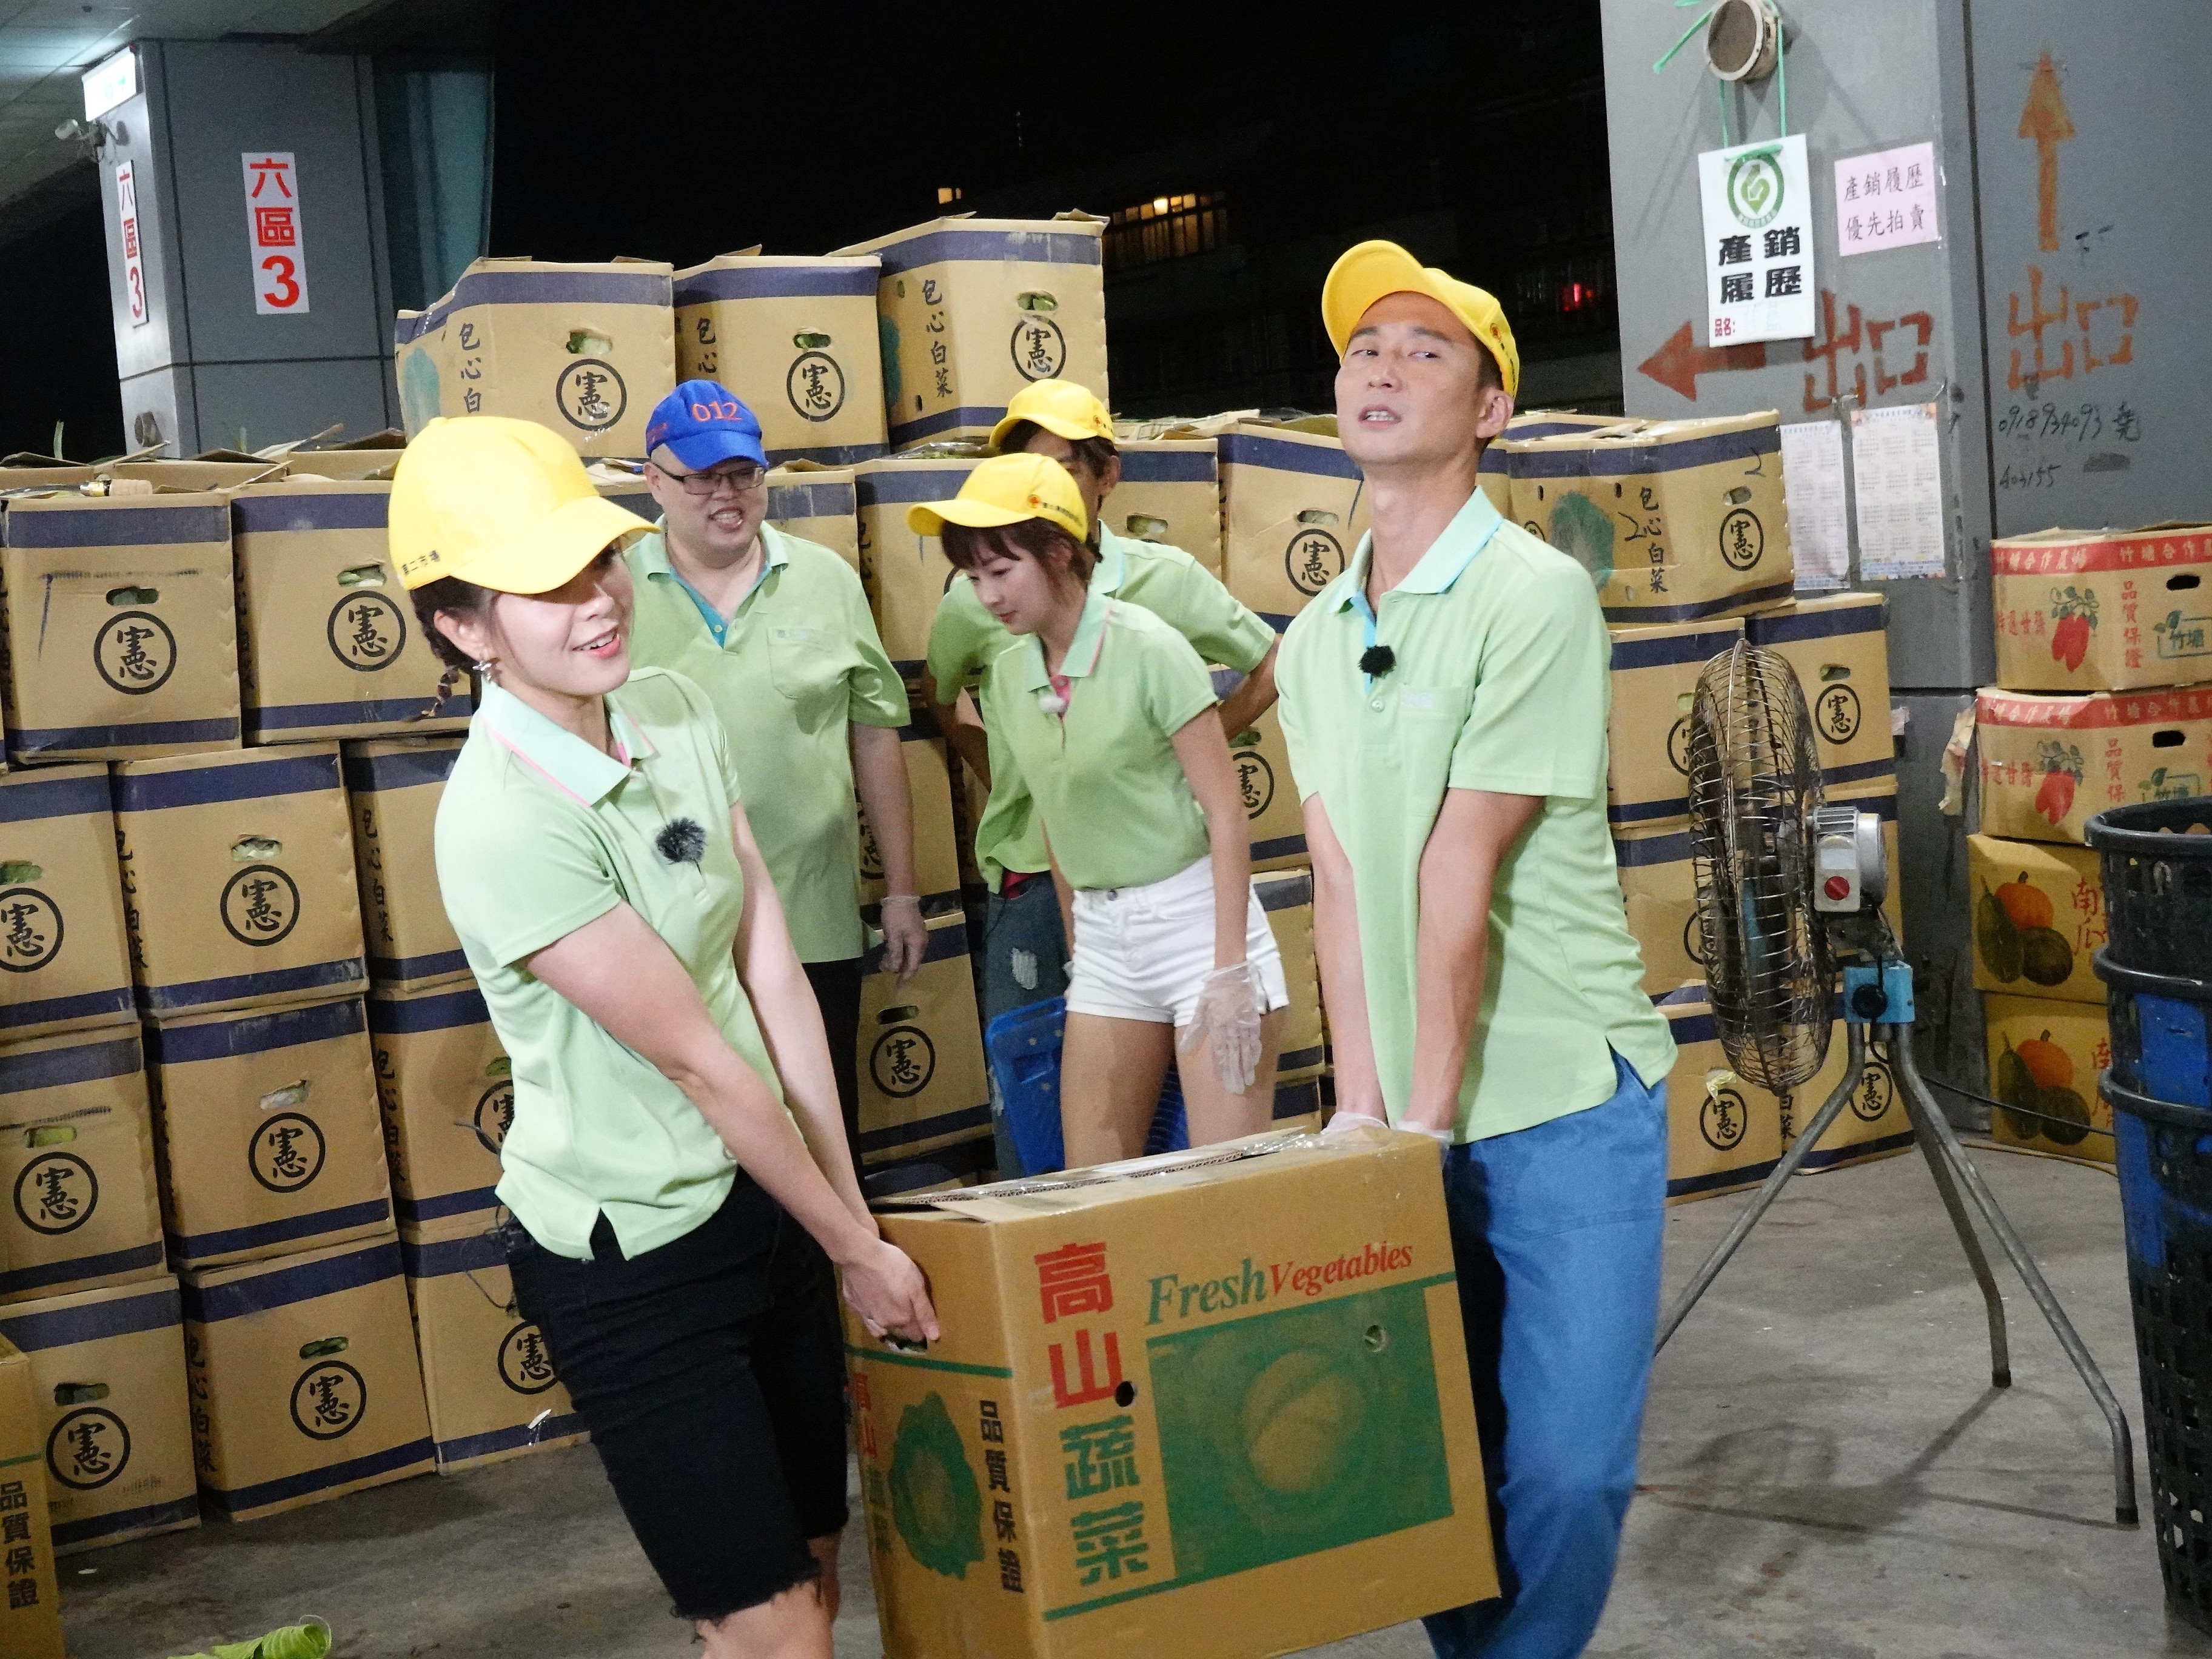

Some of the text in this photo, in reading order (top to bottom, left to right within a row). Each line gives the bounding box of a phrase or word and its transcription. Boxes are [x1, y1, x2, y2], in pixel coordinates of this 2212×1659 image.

[249, 158, 301, 308] 六區3
[1843, 163, 1924, 202] 產銷履歷
[1845, 204, 1924, 241] 優先拍賣
[119, 170, 143, 319] 六區3
[1718, 227, 1800, 266] 產銷
[1720, 266, 1801, 304] 履歷
[921, 279, 953, 398] 包心白菜
[1804, 287, 1934, 412] 出口
[2006, 266, 2138, 390] 出口
[692, 401, 742, 421] 012
[1639, 487, 1668, 594] 包心白菜
[1148, 1240, 1413, 1325] Fresh Vegetables
[1034, 1242, 1148, 1586] 高山蔬菜
[980, 1400, 1024, 1593] 品質保證
